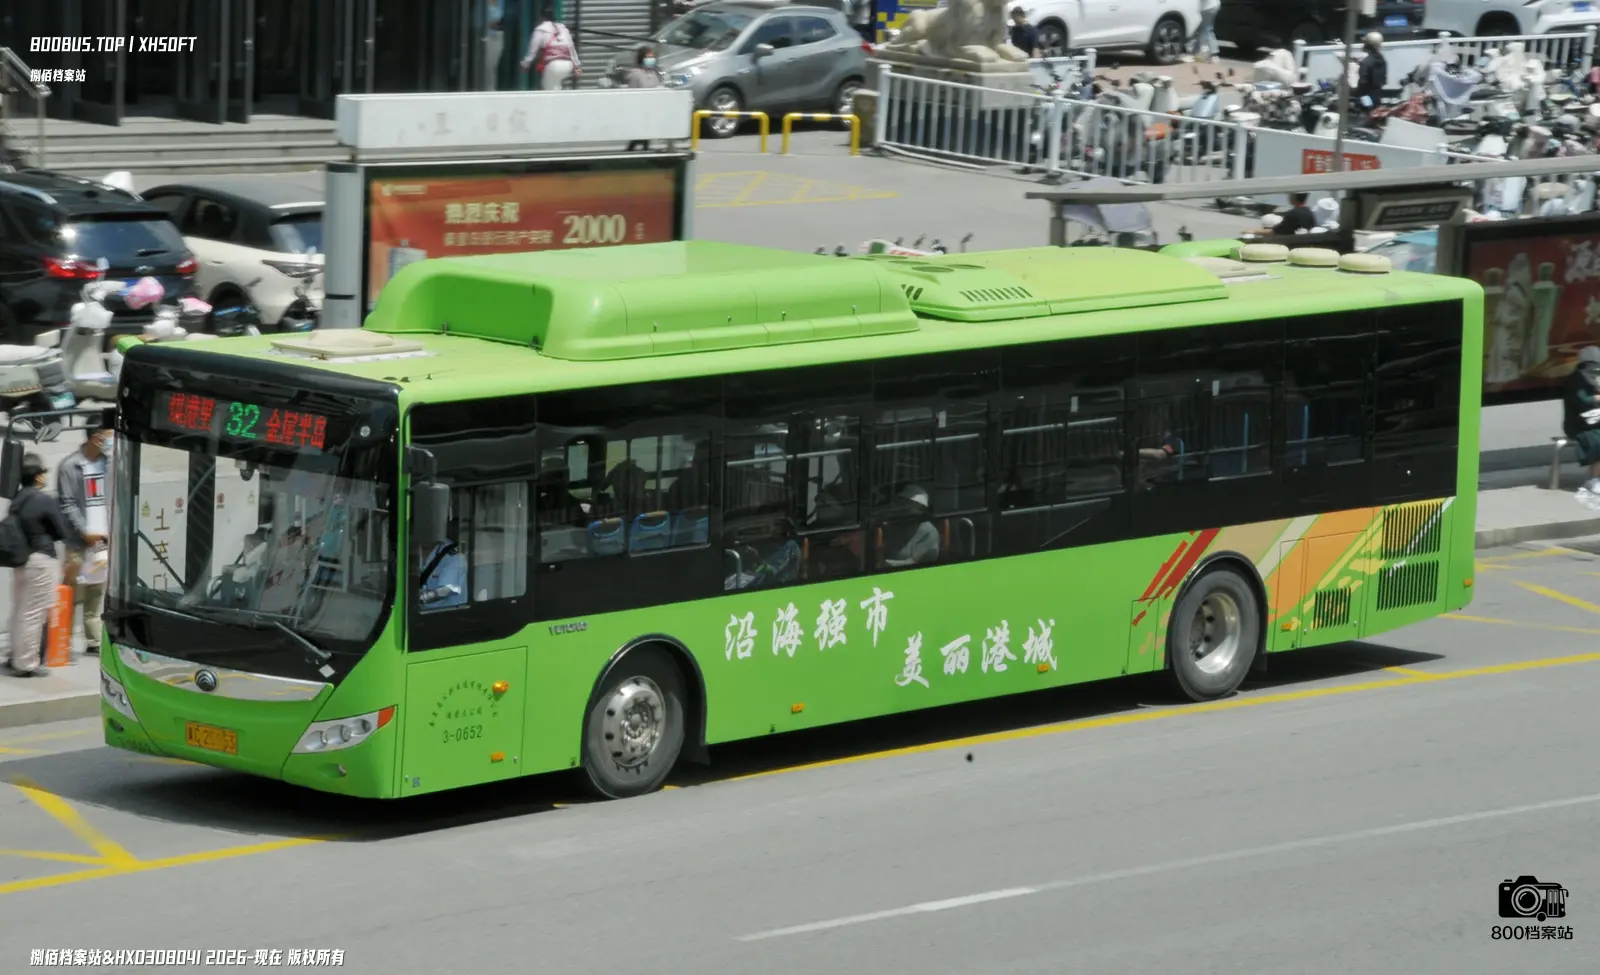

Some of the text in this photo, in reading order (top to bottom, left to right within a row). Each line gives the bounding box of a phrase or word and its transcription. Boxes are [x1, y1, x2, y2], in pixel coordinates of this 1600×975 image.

[562, 214, 627, 244] 2000
[225, 402, 261, 439] 32
[725, 587, 894, 661] 沿海强市
[895, 619, 1057, 688] 美丽港城
[442, 724, 484, 744] 3-0652
